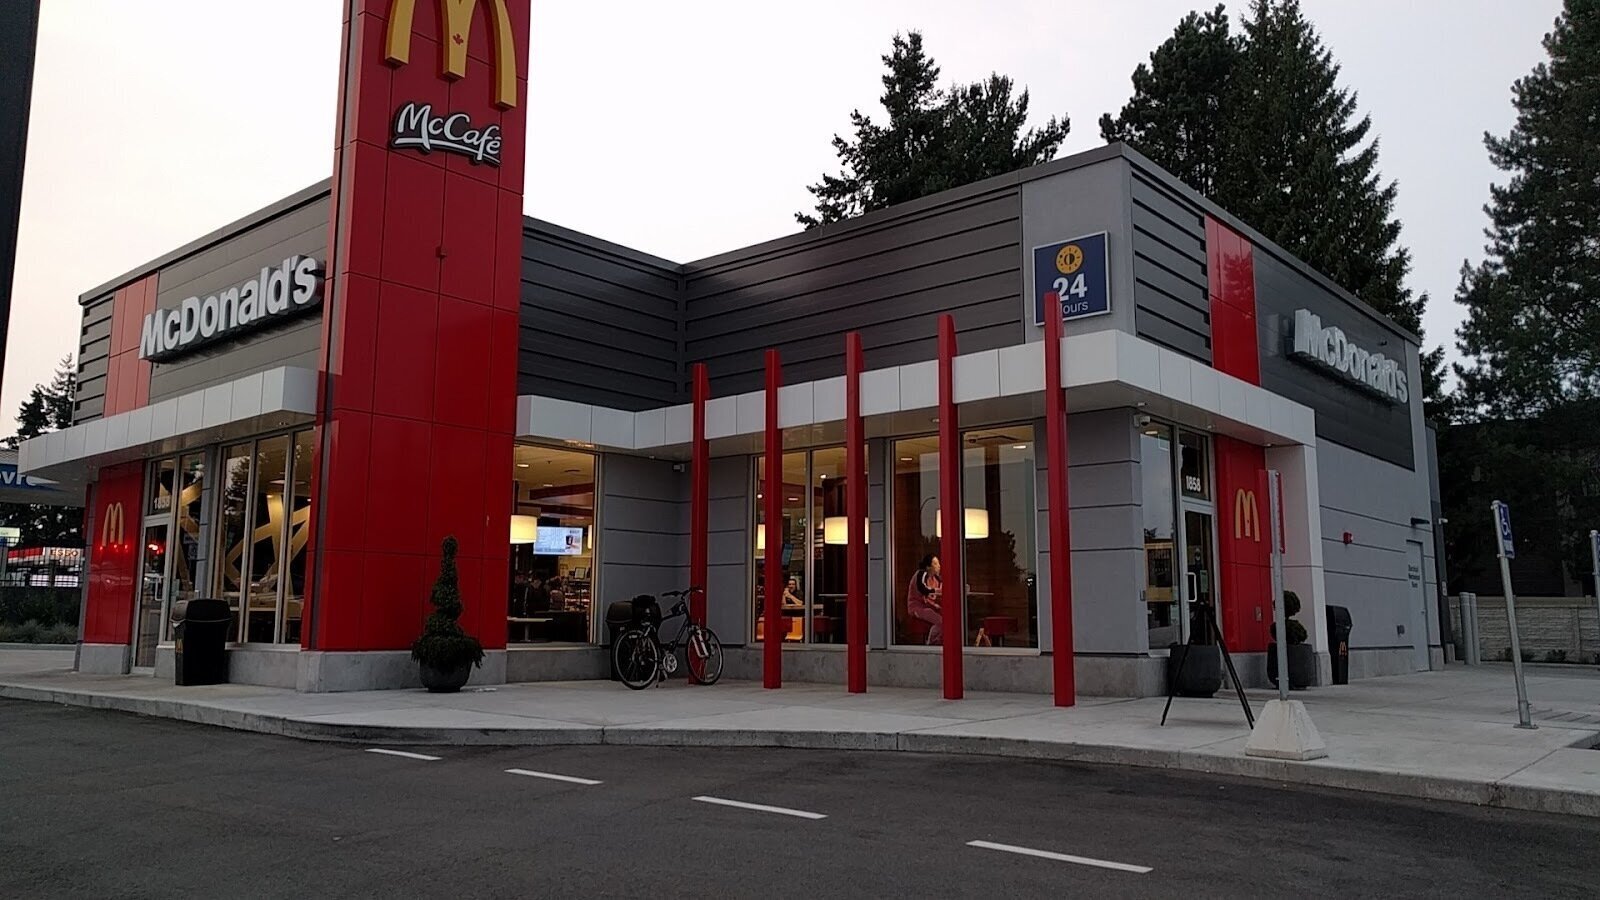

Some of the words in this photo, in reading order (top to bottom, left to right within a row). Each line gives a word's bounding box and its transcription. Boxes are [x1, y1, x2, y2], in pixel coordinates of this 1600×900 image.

[396, 103, 501, 161] McCafé
[138, 254, 318, 359] McDonald's
[1053, 273, 1088, 301] 24
[1294, 308, 1408, 403] McDonald's
[1186, 475, 1201, 492] 1858
